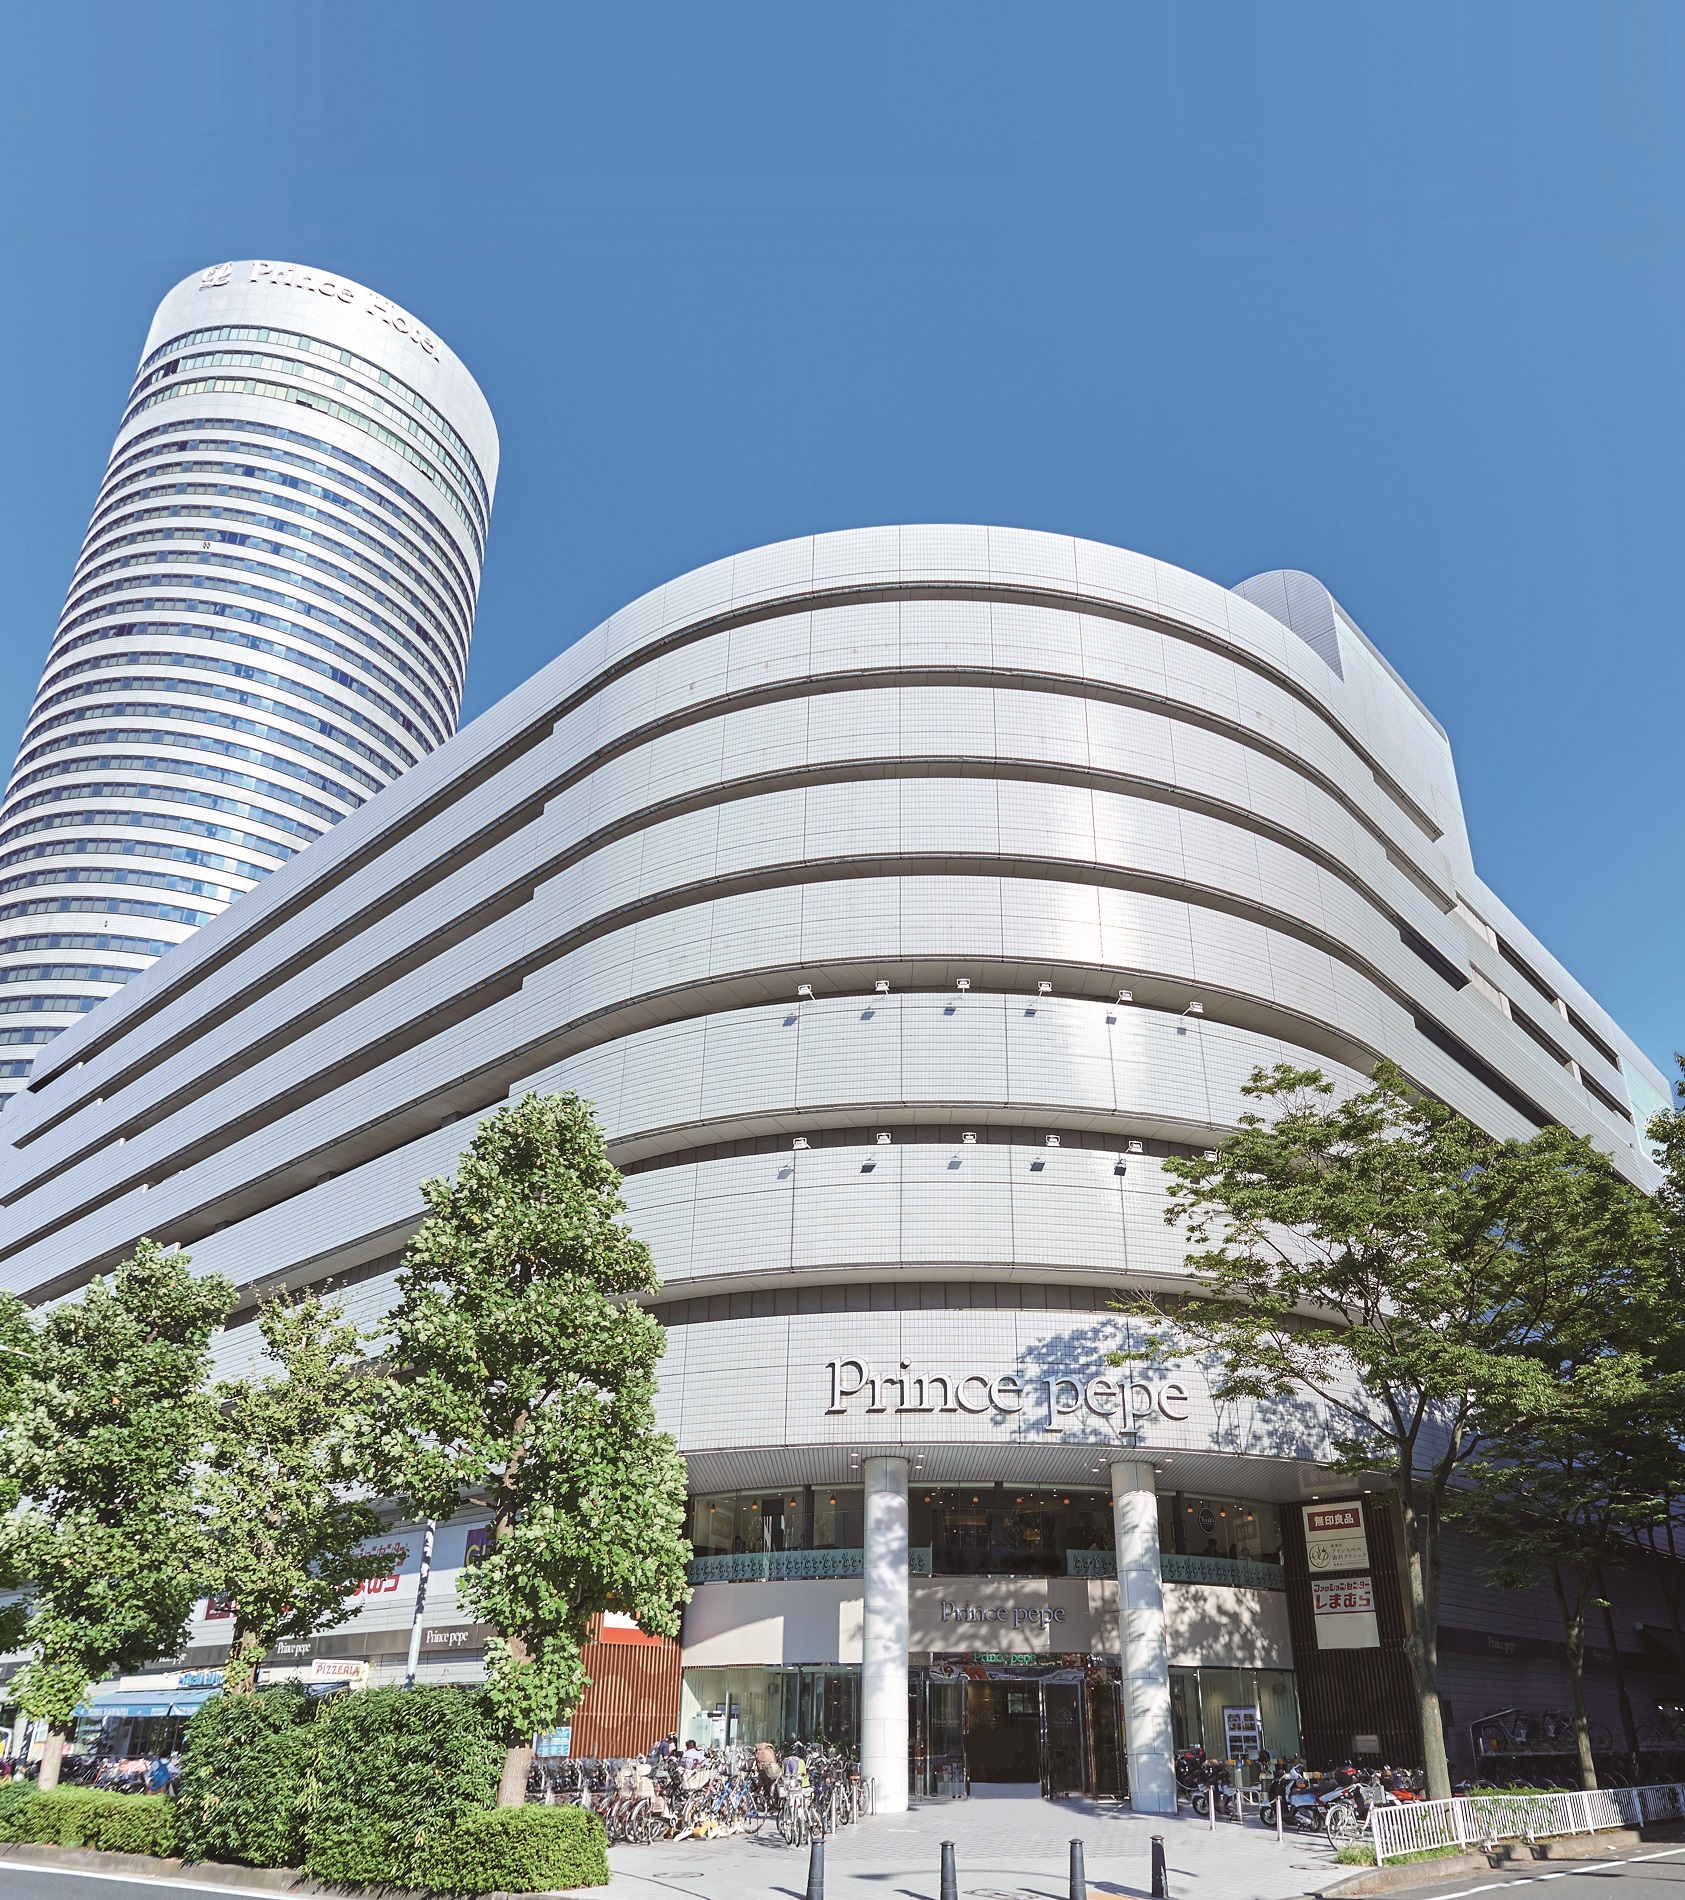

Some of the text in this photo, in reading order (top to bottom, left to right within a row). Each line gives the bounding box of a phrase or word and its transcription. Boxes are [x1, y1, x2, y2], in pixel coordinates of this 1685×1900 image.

[249, 261, 443, 364] Prince Hotel
[825, 1356, 1190, 1434] Prince pepe
[1314, 1513, 1354, 1527] 無印良品
[1313, 1581, 1370, 1593] ファッションセンター
[1315, 1590, 1371, 1610] しまむら
[940, 1600, 1066, 1630] Prince pepe
[425, 1629, 469, 1647] Prince pepe
[277, 1642, 312, 1657] Prince pepe
[973, 1652, 1037, 1665] Prince pepe
[316, 1664, 360, 1677] PIZZERIA
